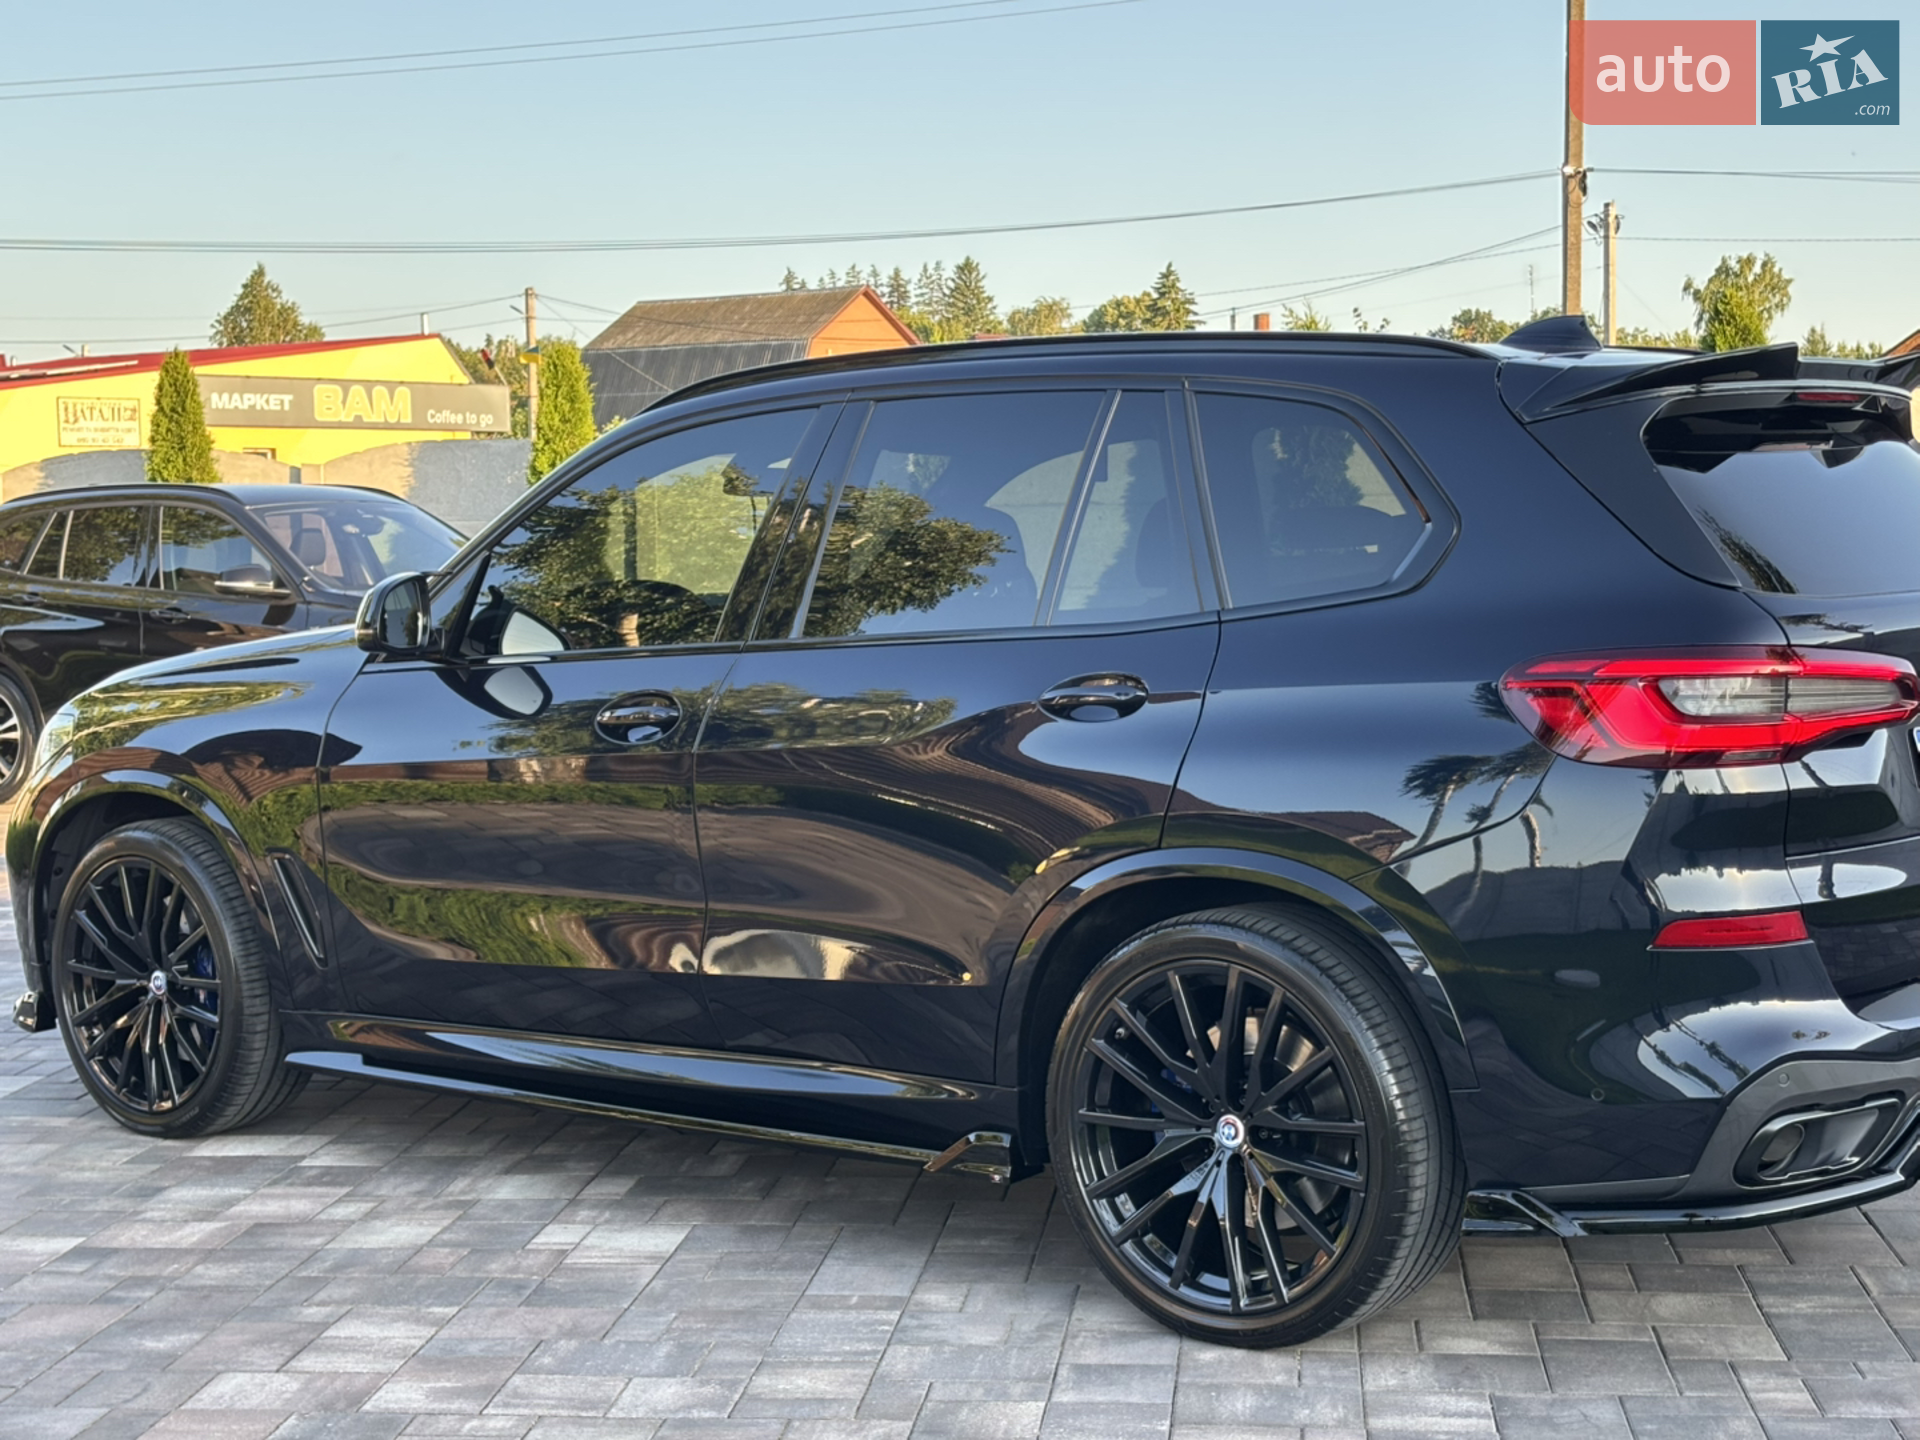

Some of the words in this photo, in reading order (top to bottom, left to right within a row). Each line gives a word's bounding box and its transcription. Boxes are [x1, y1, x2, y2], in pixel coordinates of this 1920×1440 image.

[210, 391, 293, 411] МАРКЕТ
[427, 409, 463, 424] Coffee
[466, 411, 477, 425] to
[479, 414, 493, 427] go
